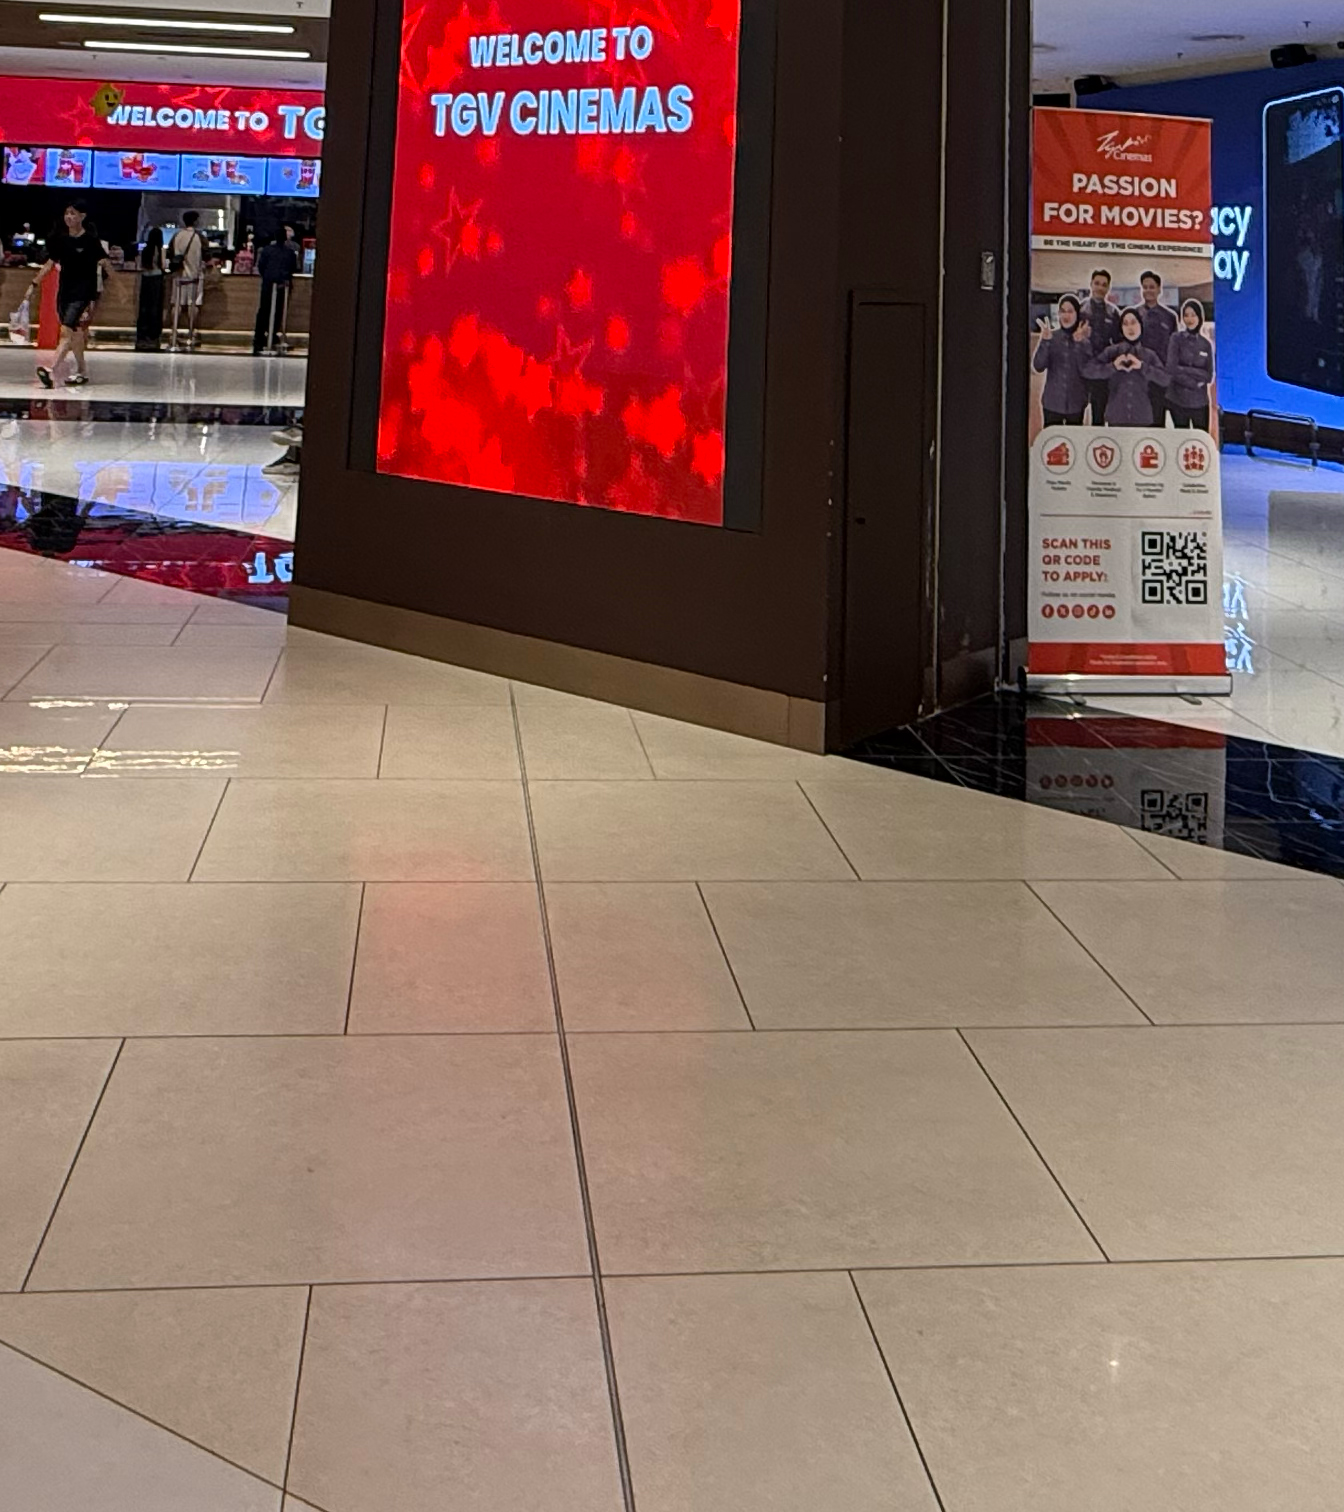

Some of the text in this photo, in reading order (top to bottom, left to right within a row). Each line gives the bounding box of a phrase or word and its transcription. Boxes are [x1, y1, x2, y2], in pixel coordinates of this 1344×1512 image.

[469, 25, 653, 68] WELCOME TO
[107, 103, 230, 131] WELCOME
[234, 110, 269, 131] TO
[430, 84, 694, 137] TGV CINEMAS
[1113, 150, 1153, 163] Cinemas
[1072, 173, 1177, 198] PASSION
[1043, 202, 1204, 230] FOR MOVIES?
[1056, 240, 1071, 248] THE
[1072, 240, 1097, 248] HEART
[1127, 243, 1156, 251] CINEMA
[1042, 538, 1112, 550] SCAN THIS
[1042, 554, 1101, 566] QR CODE
[1041, 570, 1060, 582] TO
